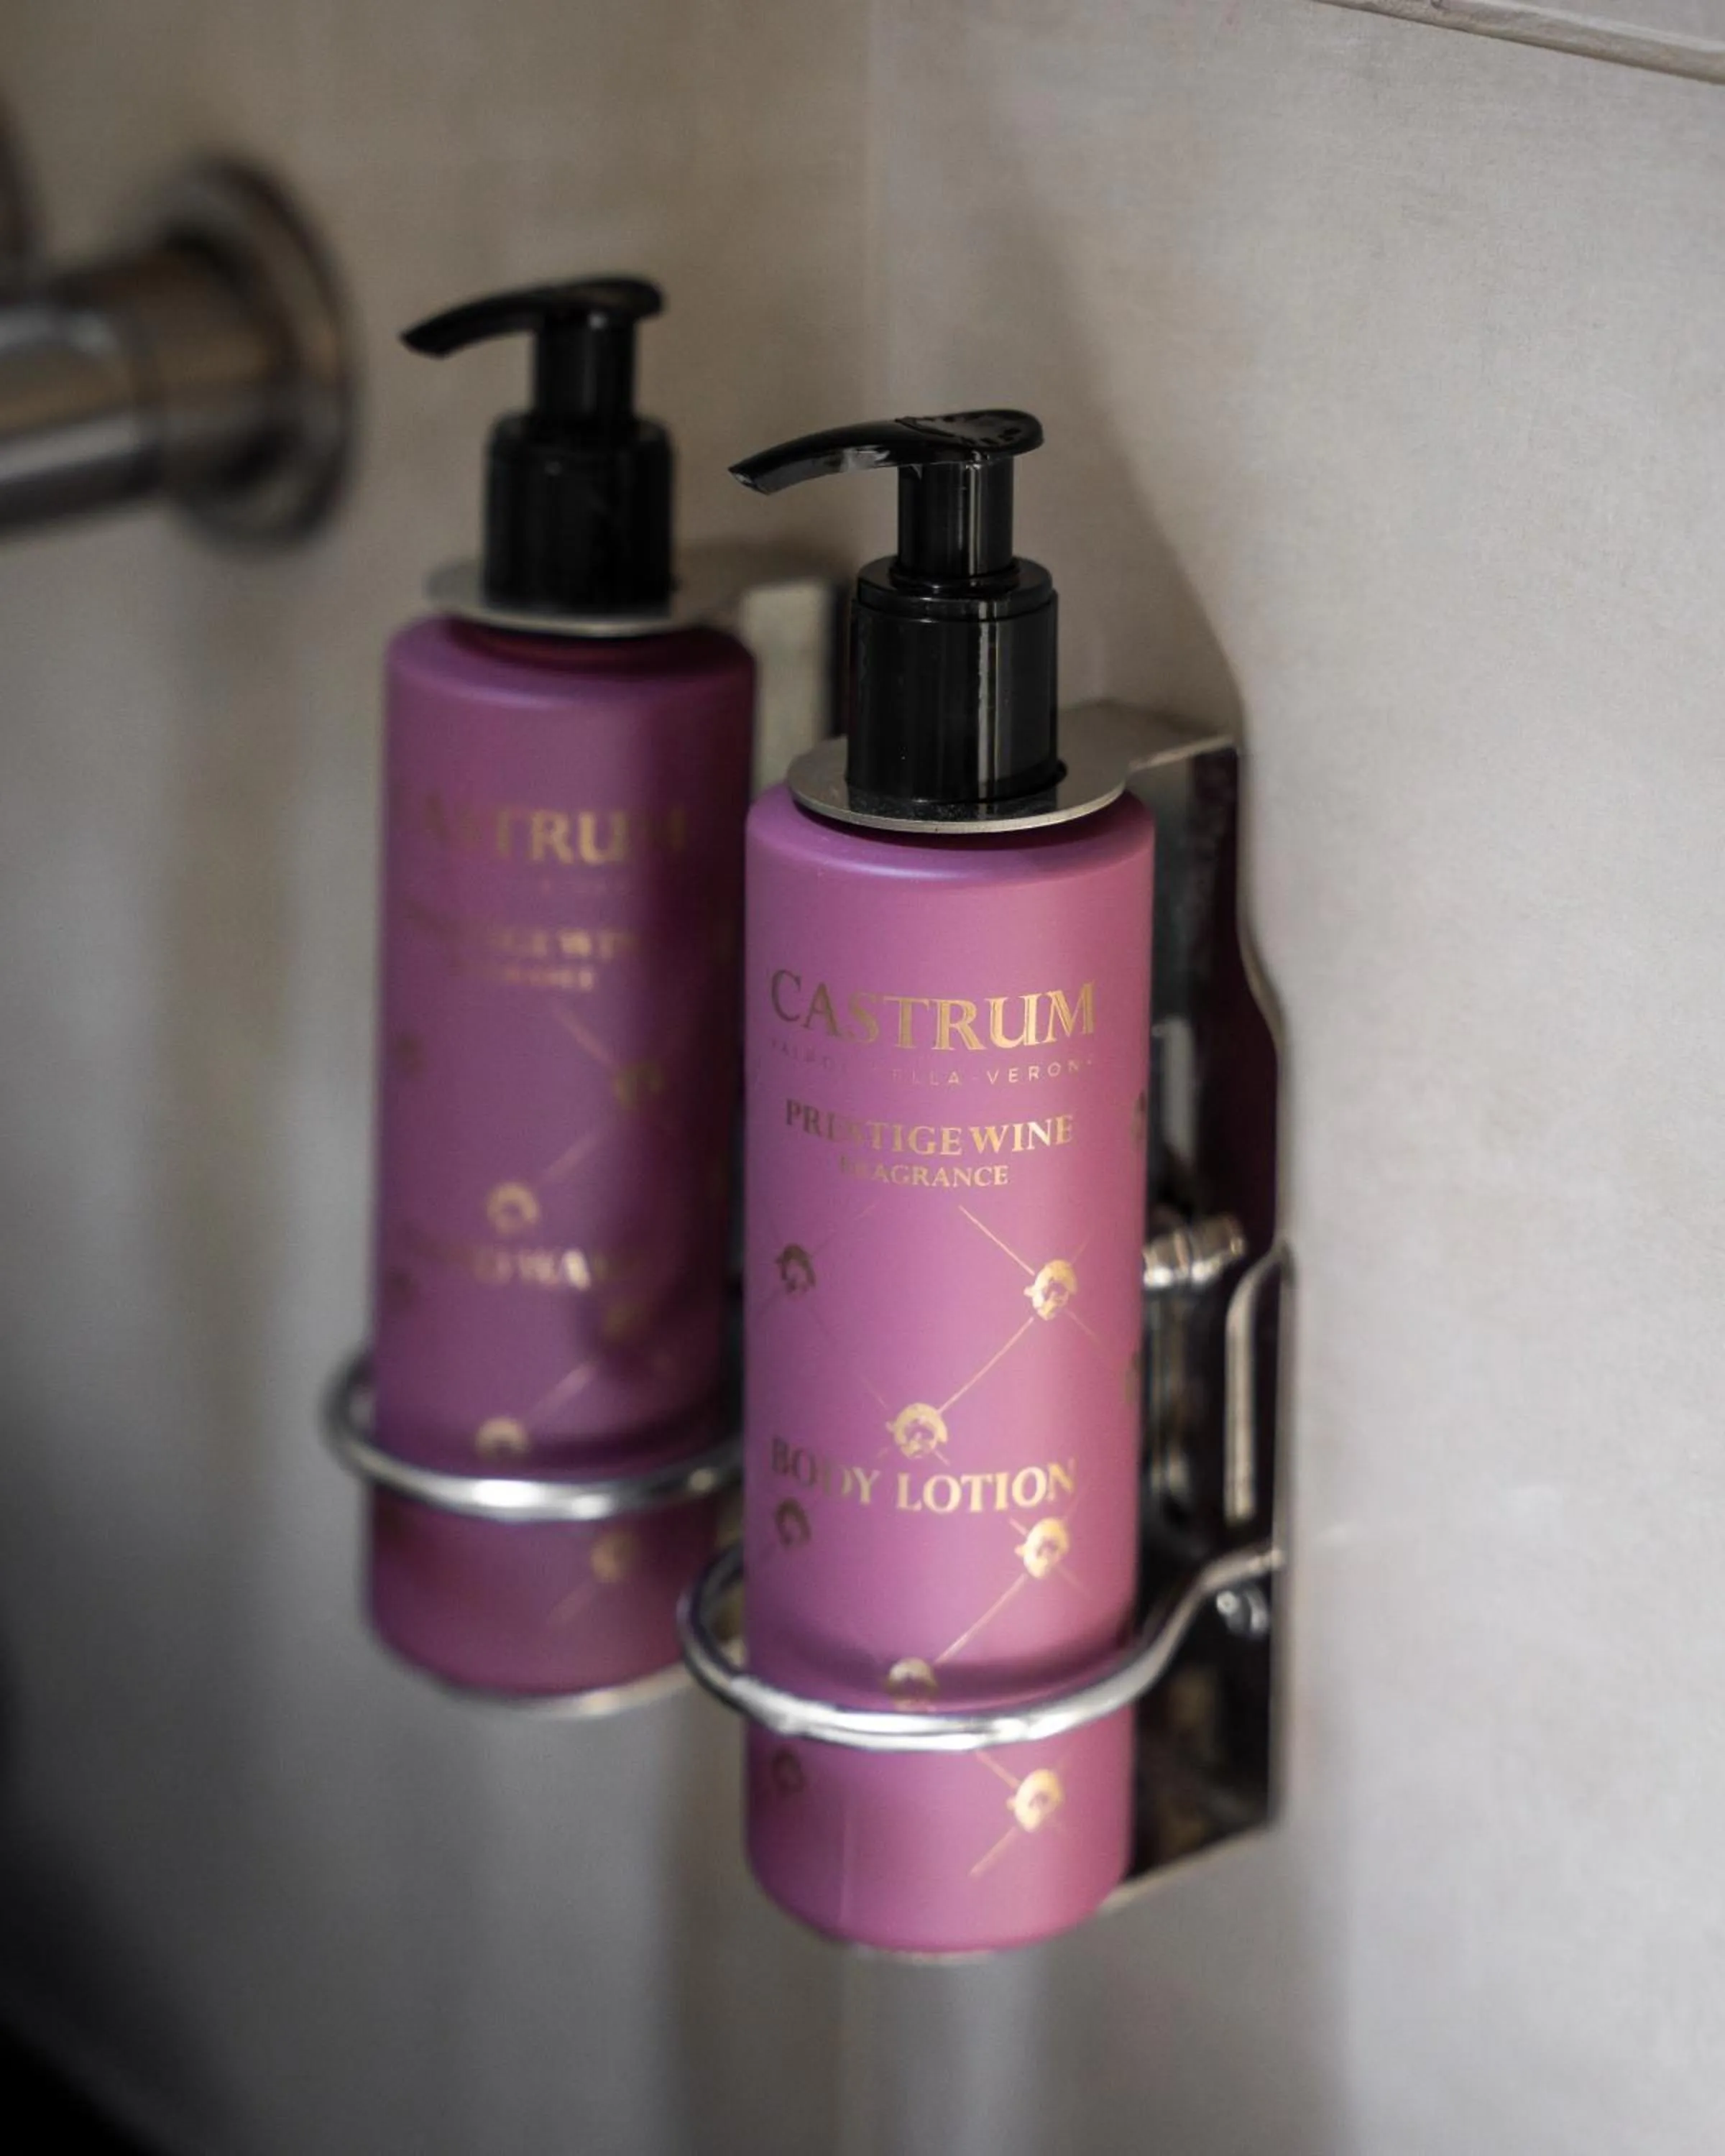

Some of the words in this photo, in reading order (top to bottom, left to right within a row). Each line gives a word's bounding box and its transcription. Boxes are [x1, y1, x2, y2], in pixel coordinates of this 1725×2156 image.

[771, 969, 1095, 1051] CASTRUM
[986, 1054, 1093, 1085] VERON
[971, 1115, 1073, 1153] WINE
[897, 1458, 1075, 1513] LOTION
